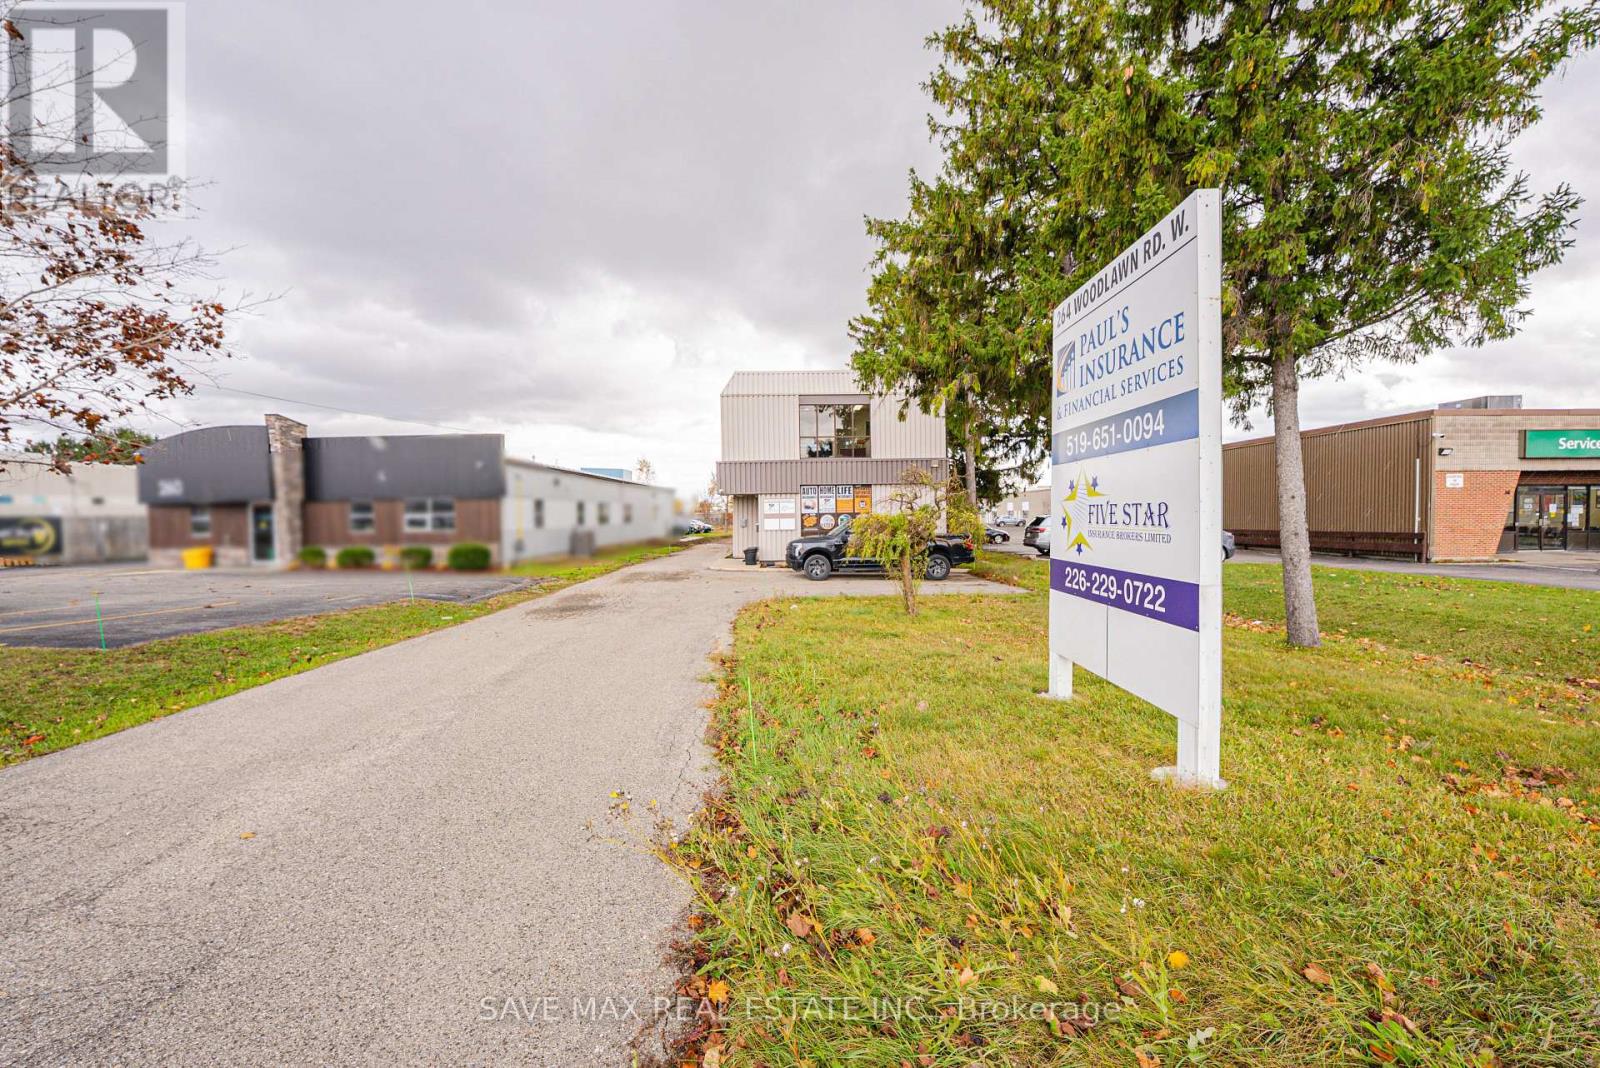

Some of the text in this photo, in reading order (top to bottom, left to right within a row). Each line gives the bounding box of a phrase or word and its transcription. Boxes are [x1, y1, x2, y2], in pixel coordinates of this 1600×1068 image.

[1057, 209, 1189, 327] 264 WOODLAWN RD. W.
[1080, 305, 1129, 357] PAUL'S
[1080, 311, 1185, 388] INSURANCE
[1056, 355, 1184, 420] & FINANCIAL SERVICES
[1066, 409, 1164, 456] 519-651-0094
[802, 487, 817, 495] AUTO
[820, 486, 834, 495] HOME
[837, 486, 851, 495] LIFE
[1088, 501, 1168, 528] FIVE STAR
[1088, 529, 1172, 544] INSURANCE BROKERS LIMITED
[1065, 567, 1166, 612] 226-229-0722
